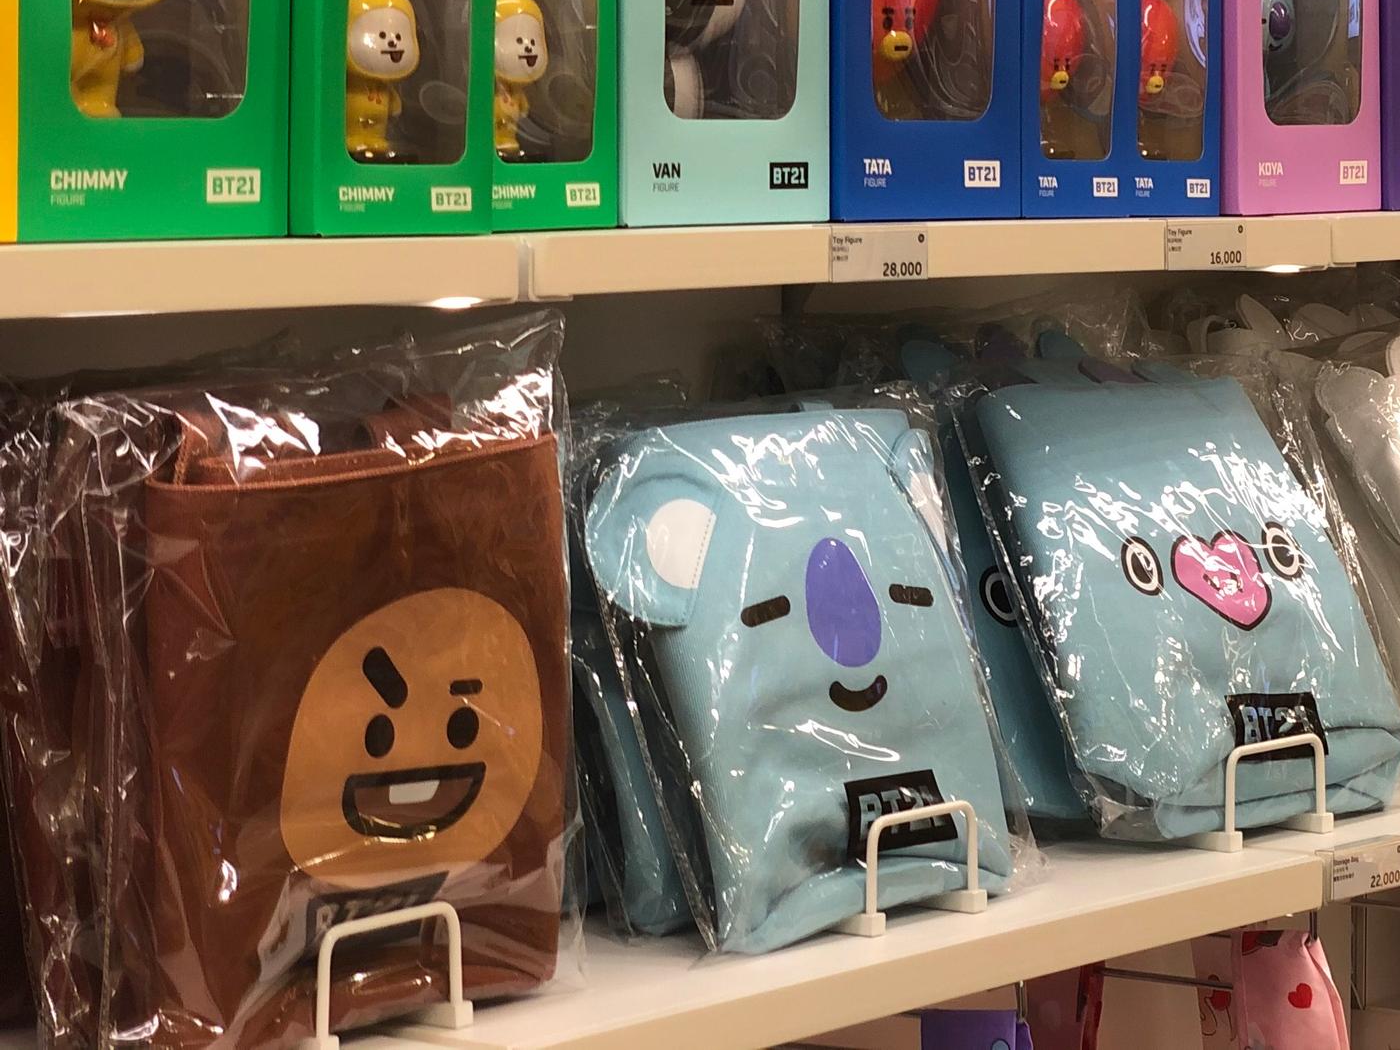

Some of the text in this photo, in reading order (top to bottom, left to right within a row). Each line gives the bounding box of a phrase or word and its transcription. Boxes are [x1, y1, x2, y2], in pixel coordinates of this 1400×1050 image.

[652, 163, 681, 179] VAN
[863, 158, 893, 175] TATA
[968, 166, 997, 181] BT21
[1258, 162, 1284, 176] KOYA
[1342, 165, 1365, 180] BT21
[50, 169, 128, 190] CHIMMY
[773, 167, 805, 184] BT21
[863, 177, 887, 188] FIGURE
[1038, 176, 1059, 189] TATA
[212, 176, 255, 195] BT21
[652, 182, 680, 192] FIGURE
[1095, 181, 1116, 193] BT21
[1135, 177, 1154, 189] TATA
[1189, 183, 1208, 194] BT21
[339, 186, 395, 201] CHIMMY
[435, 192, 468, 206] BT21
[492, 185, 536, 199] CHIMMY
[569, 188, 597, 202] BT21
[50, 194, 86, 206] FIGURE
[833, 236, 862, 245] Toy Figure
[1210, 250, 1242, 265] 16,000
[882, 262, 922, 277] 28,000
[1370, 870, 1400, 888] 22,000
